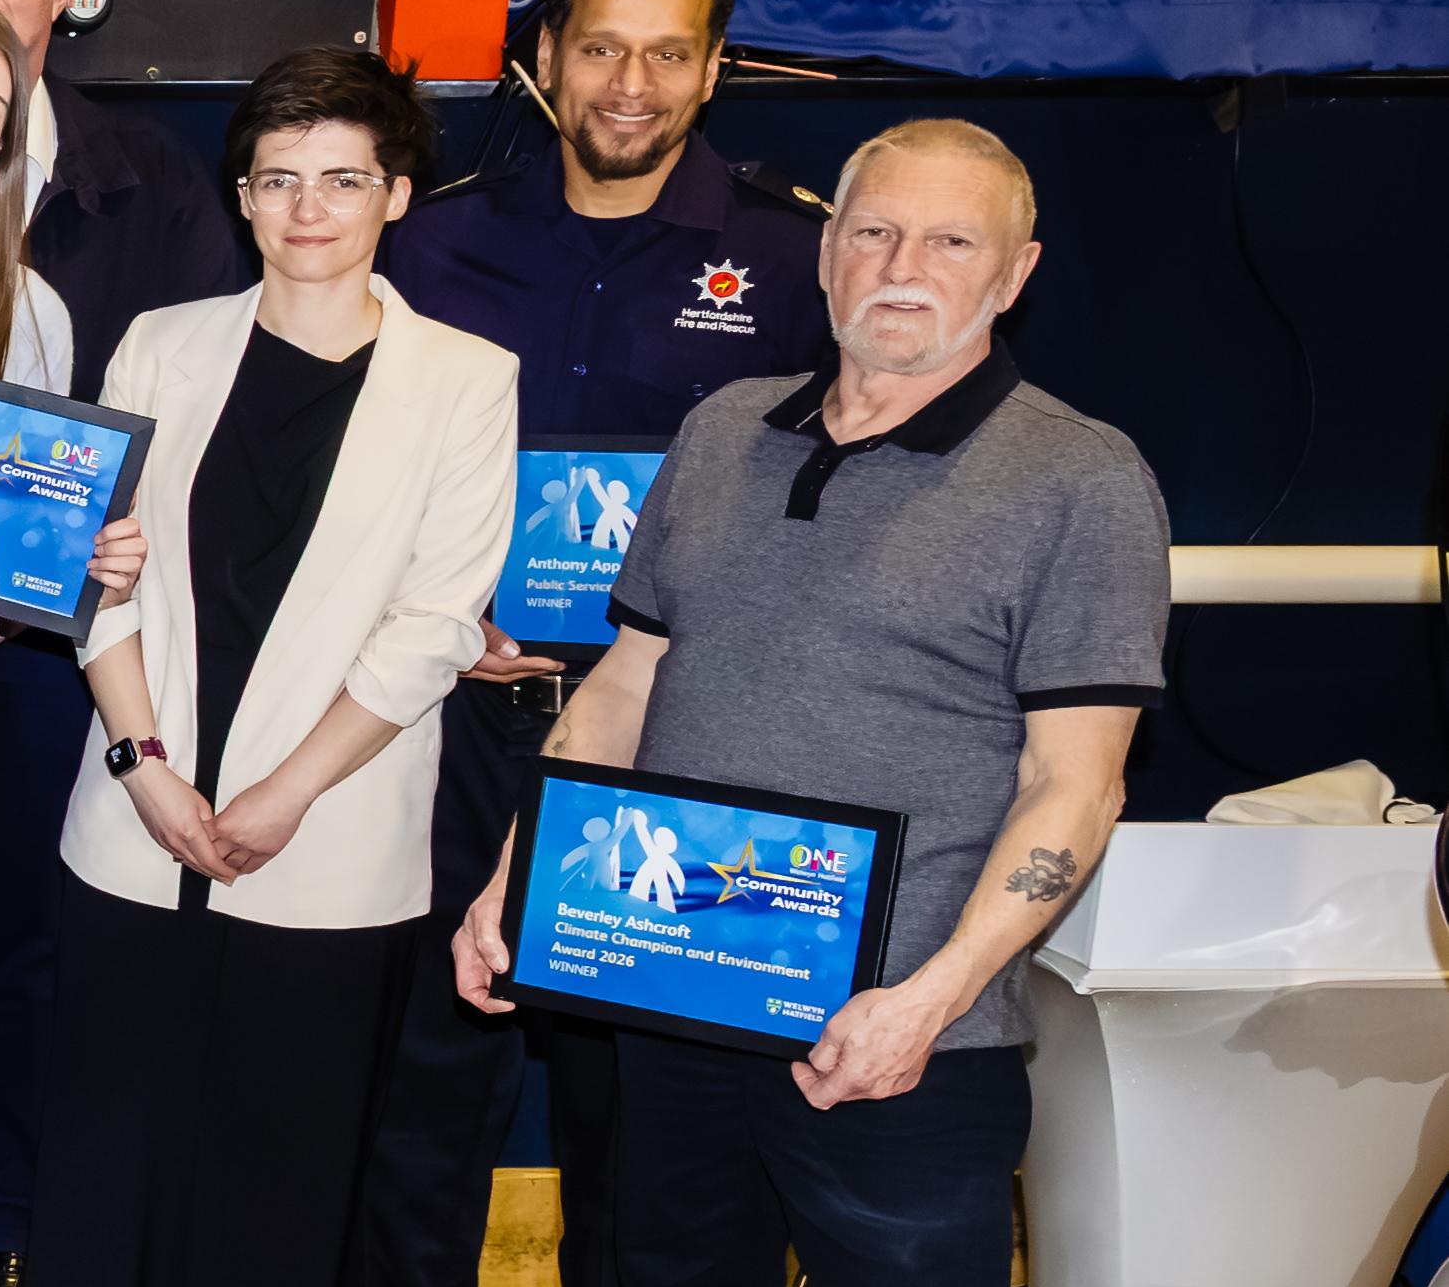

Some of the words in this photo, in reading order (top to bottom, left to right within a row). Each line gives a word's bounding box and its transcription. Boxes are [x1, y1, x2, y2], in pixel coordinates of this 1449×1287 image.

[674, 318, 695, 328] Fire
[697, 321, 718, 330] and
[718, 322, 755, 334] Rescue
[682, 308, 753, 323] Hertfordshire
[51, 439, 102, 469] ONE
[0, 463, 92, 496] Community
[28, 483, 88, 507] Awards
[527, 557, 588, 573] Anthony
[526, 578, 565, 591] Public
[526, 597, 572, 609] WINNER
[790, 844, 849, 874] ONE
[735, 876, 843, 906] Community
[770, 897, 840, 918] Awards
[557, 902, 622, 929] Beverley
[624, 916, 691, 939] Ashcroft
[551, 941, 596, 960] Award
[598, 950, 635, 967] 2026
[554, 922, 608, 942] Climate
[611, 932, 683, 956] Champion
[686, 948, 714, 962] and
[717, 952, 811, 980] Environment
[549, 959, 598, 978] WINNER
[782, 1009, 824, 1023] HATFIELD
[783, 1001, 825, 1015] WELWYN
